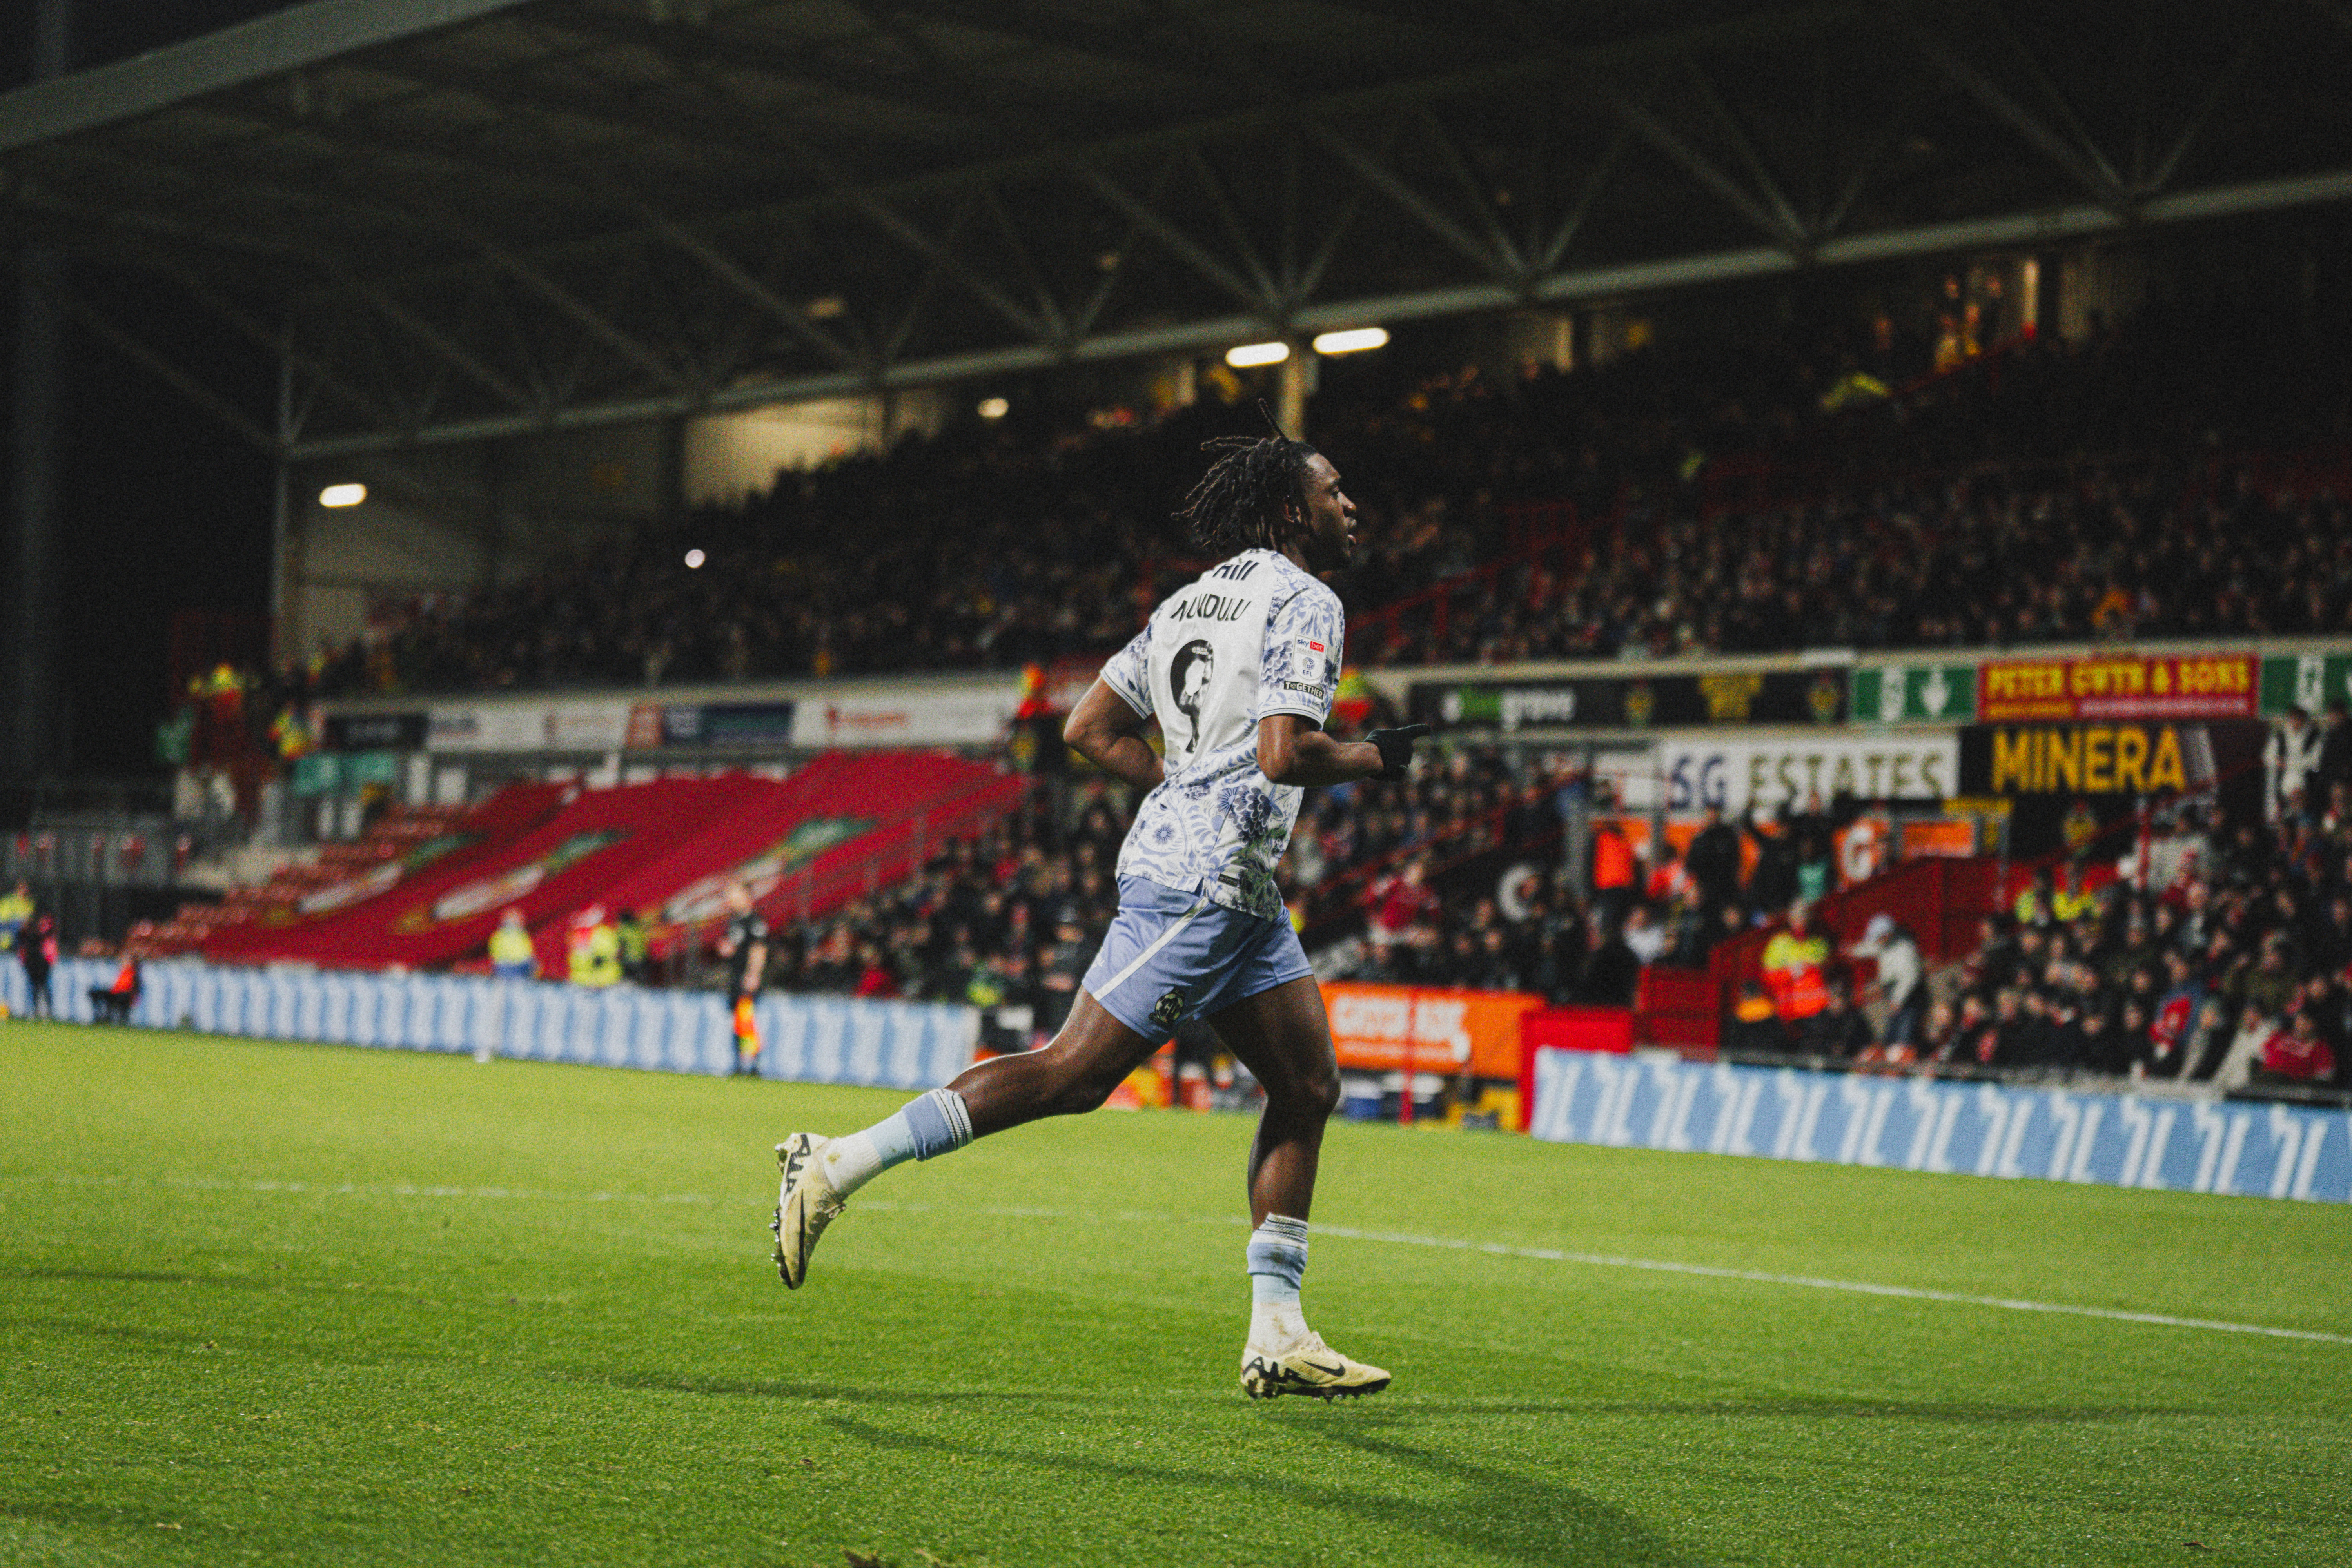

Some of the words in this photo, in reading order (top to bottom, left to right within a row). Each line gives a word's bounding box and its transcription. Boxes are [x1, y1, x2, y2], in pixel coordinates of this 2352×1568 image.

[1297, 647, 1313, 655] LEAGUE
[1987, 664, 2064, 697] PETER
[2178, 661, 2250, 693] SONS
[1170, 639, 1214, 753] 9
[1669, 753, 1725, 810] SG
[1748, 751, 1942, 803] ESTATES
[1991, 724, 2187, 793] MINERA
